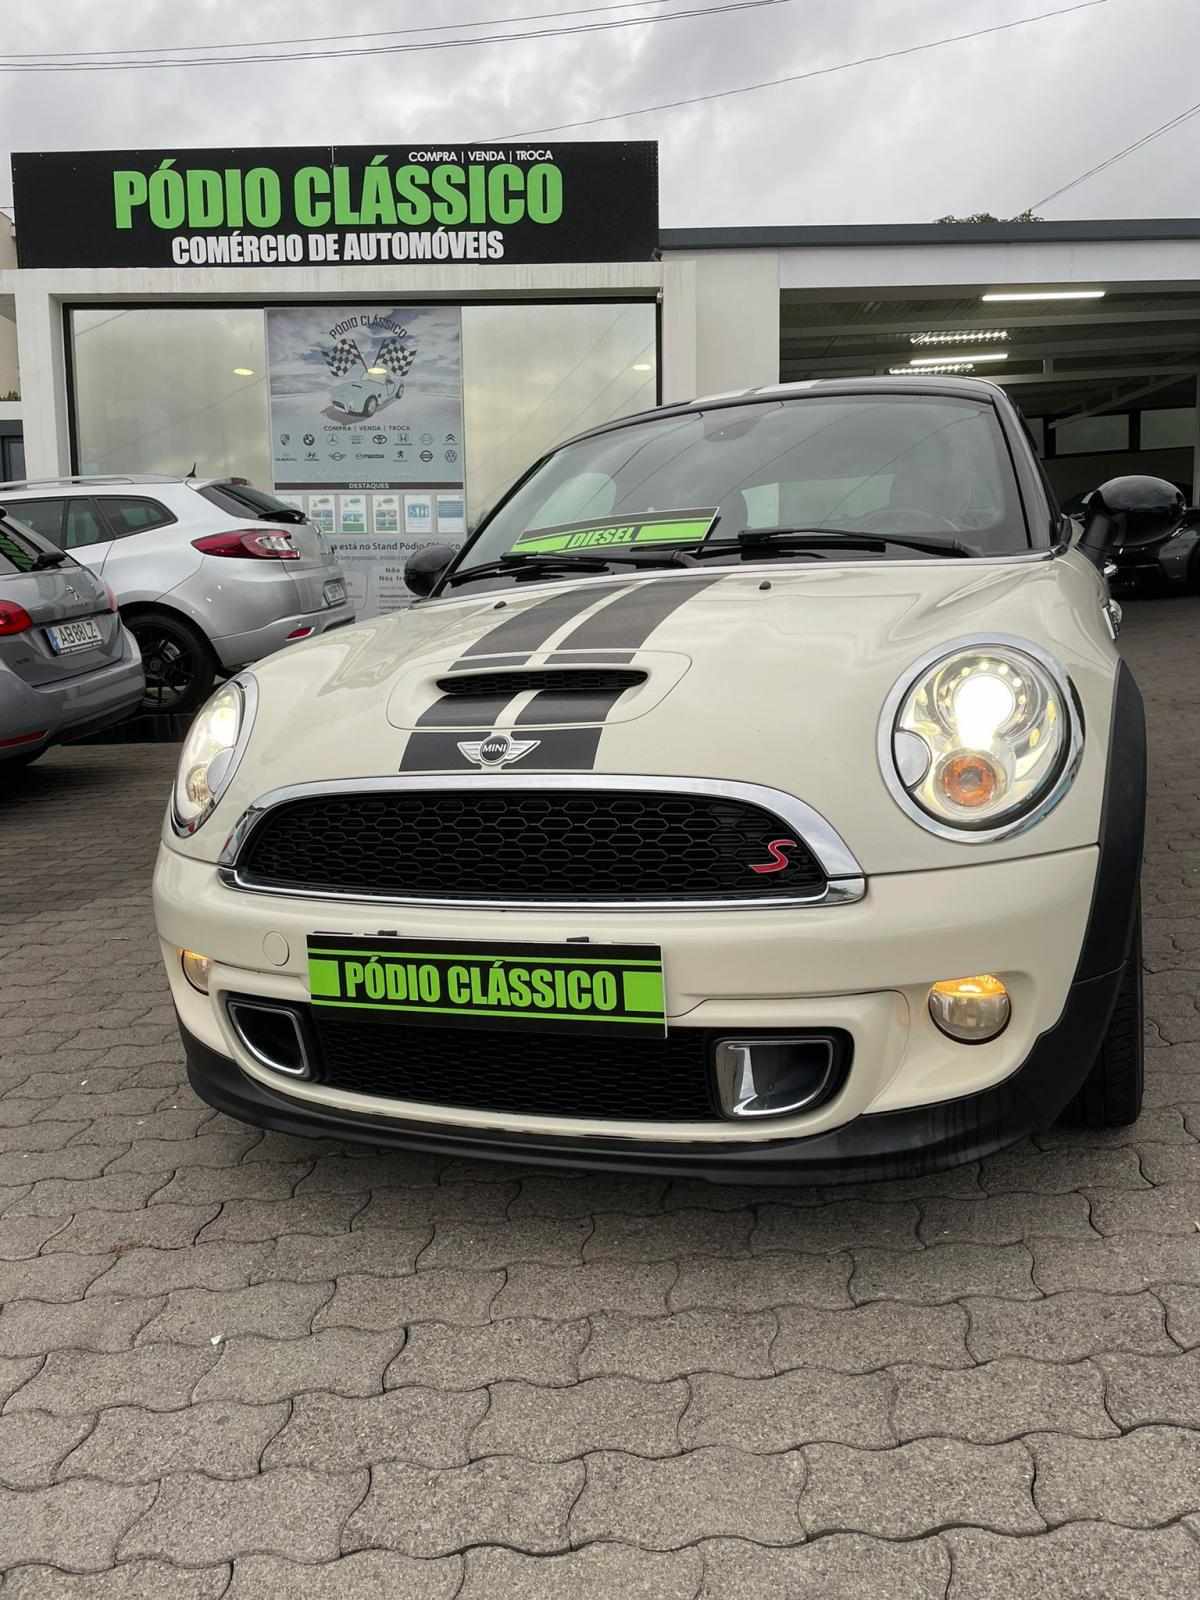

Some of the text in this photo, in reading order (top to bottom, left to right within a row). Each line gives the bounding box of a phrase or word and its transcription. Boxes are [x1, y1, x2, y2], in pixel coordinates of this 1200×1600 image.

[408, 150, 554, 162] COMPRA VENDA TROCA
[113, 154, 563, 230] PÓDIO CLÁSSICO
[172, 227, 505, 265] COMÉRCIO DE AUTOMÓVEIS
[329, 313, 408, 340] PÓDIO CLÁSSICO
[348, 482, 390, 490] DESTAQUES
[372, 542, 398, 551] Stand
[567, 527, 633, 548] DIESEL
[482, 743, 507, 753] MINI
[748, 839, 798, 873] S
[344, 956, 618, 1011] PÓDIO CLÁSSICO
